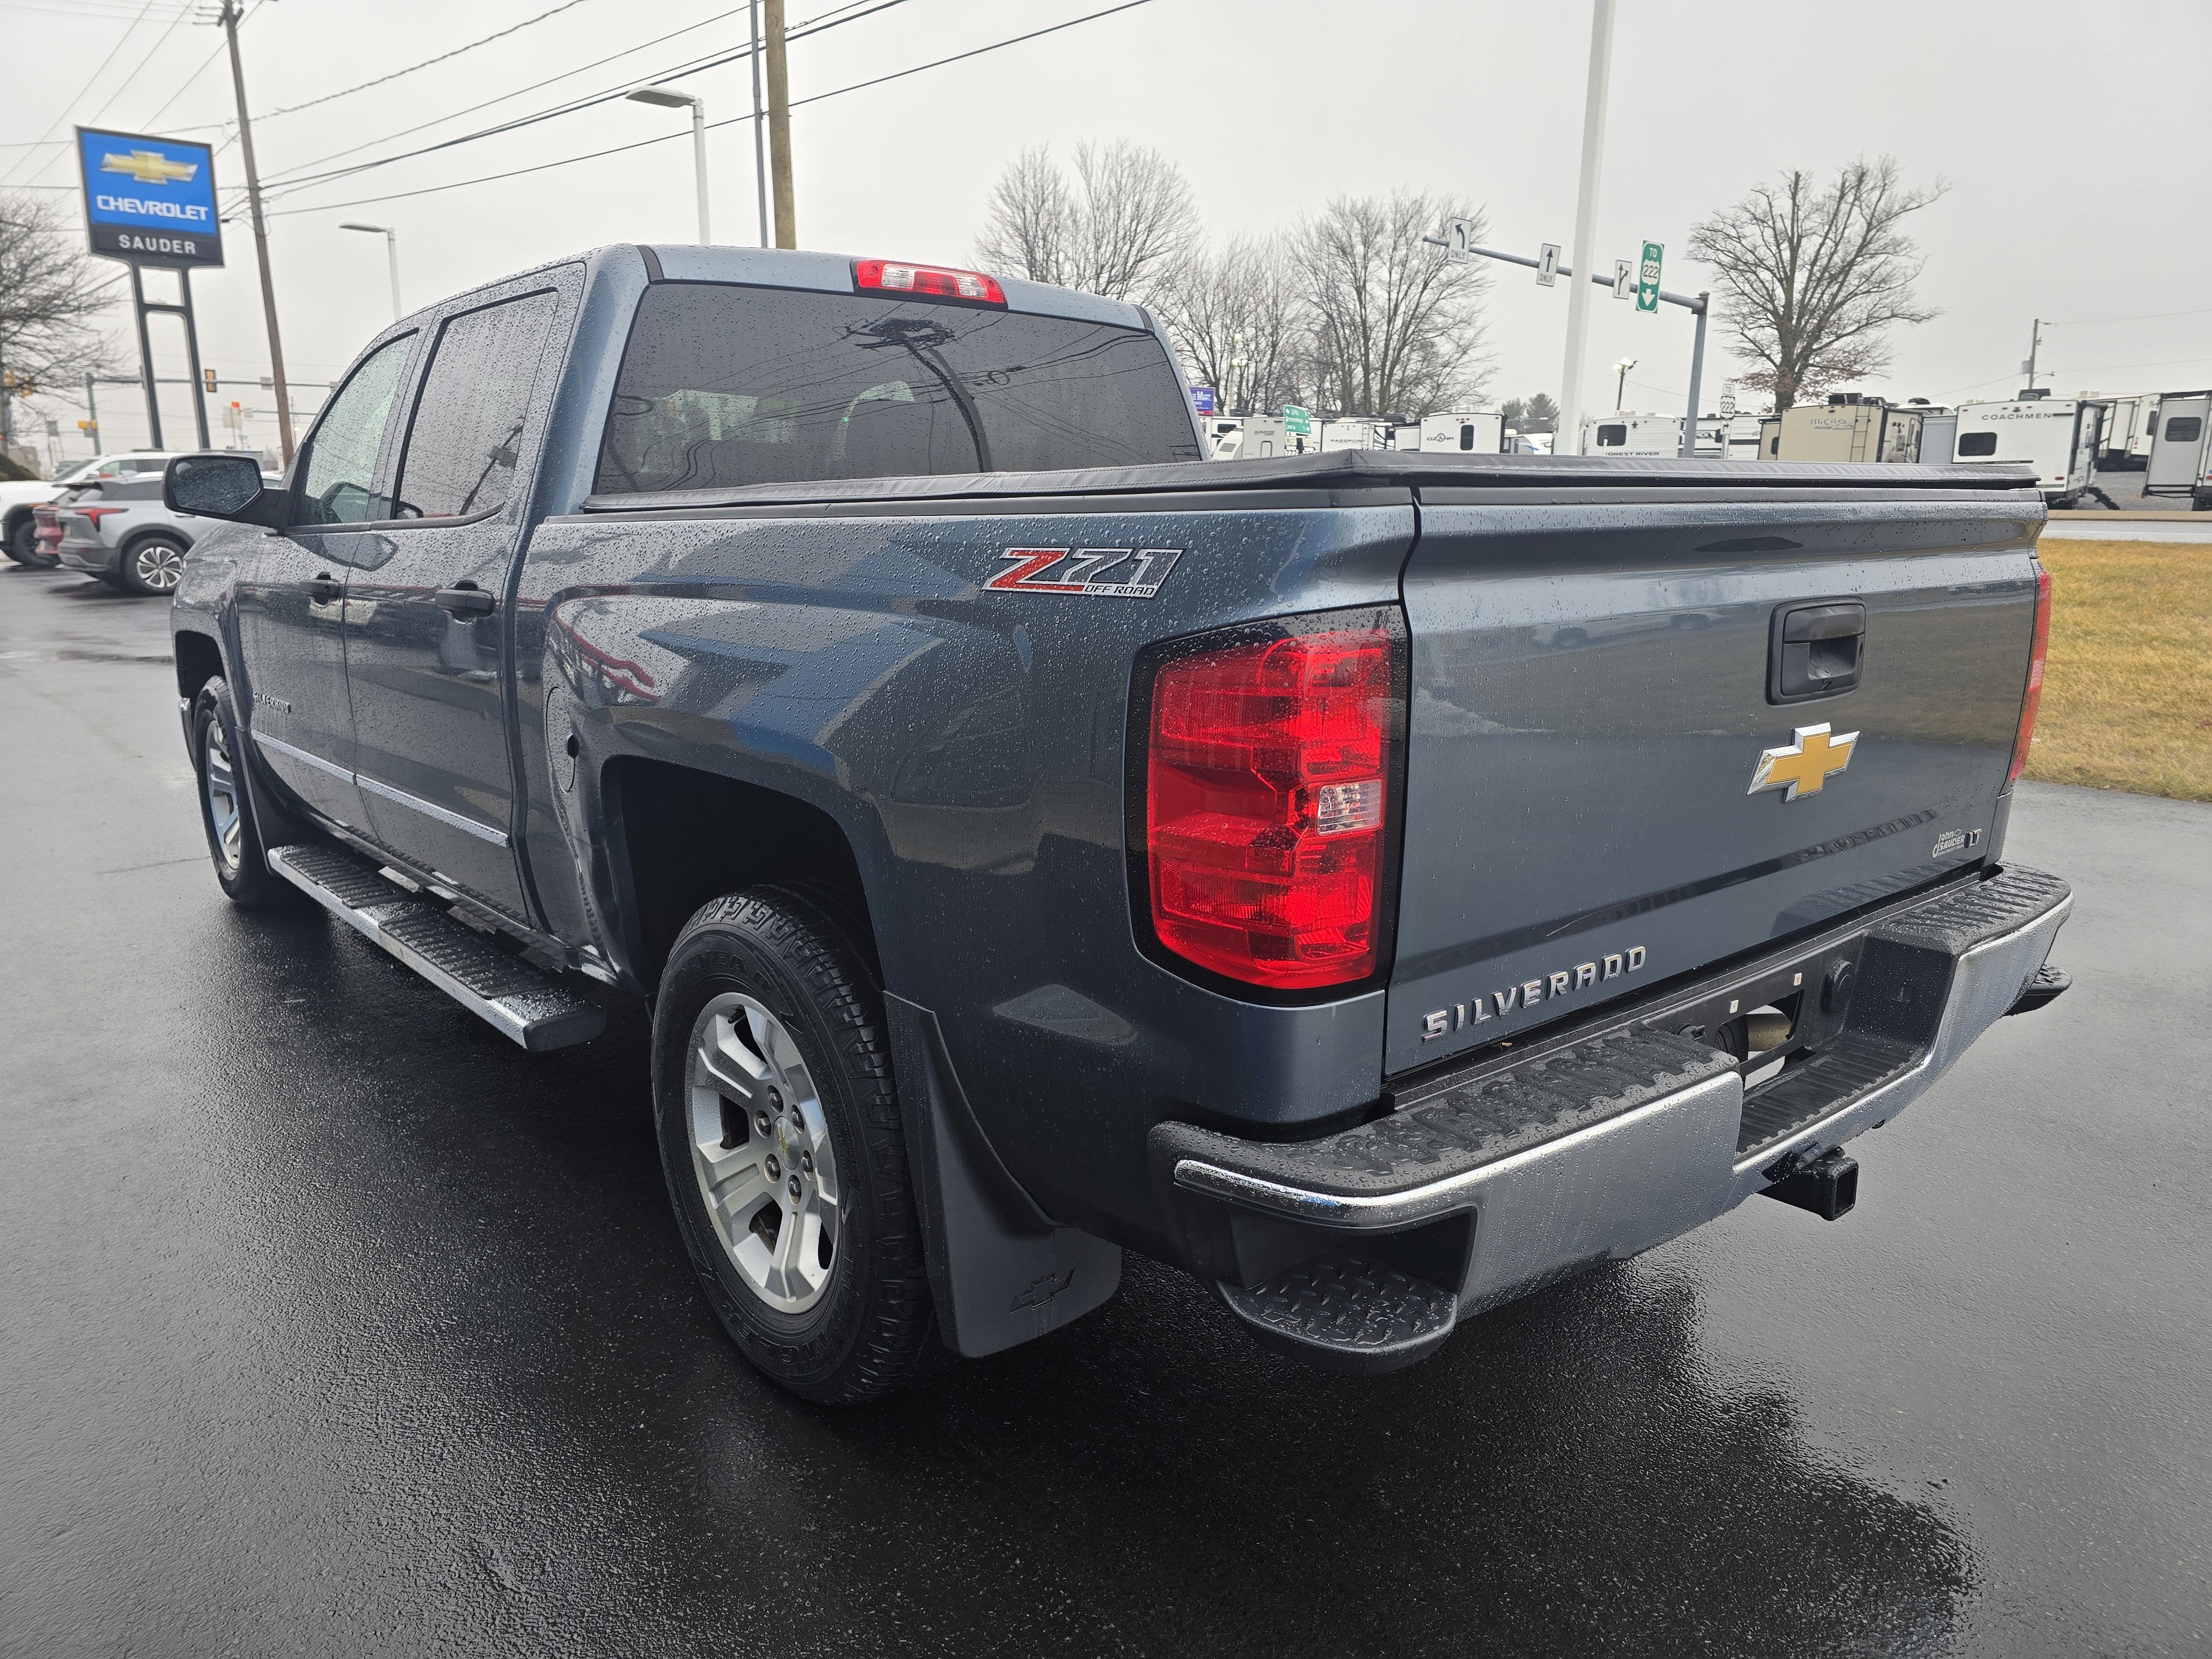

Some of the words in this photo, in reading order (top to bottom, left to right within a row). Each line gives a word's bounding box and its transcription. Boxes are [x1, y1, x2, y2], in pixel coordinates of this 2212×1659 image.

[96, 195, 208, 221] CHEVROLET
[118, 234, 196, 254] SAUDER
[1450, 249, 1465, 259] ONLY
[1649, 247, 1658, 258] TO
[1539, 274, 1553, 283] ONLY
[1643, 264, 1658, 279] 222
[1721, 401, 1734, 414] 222
[1981, 410, 2051, 420] COACHMEN
[980, 546, 1186, 598] Z71
[1084, 584, 1112, 593] OFF
[1113, 585, 1156, 596] ROAD
[1932, 831, 1954, 858] John
[1939, 834, 1965, 852] SAUDER
[1965, 828, 1983, 848] LT
[1421, 945, 1646, 1043] SILVERADO
